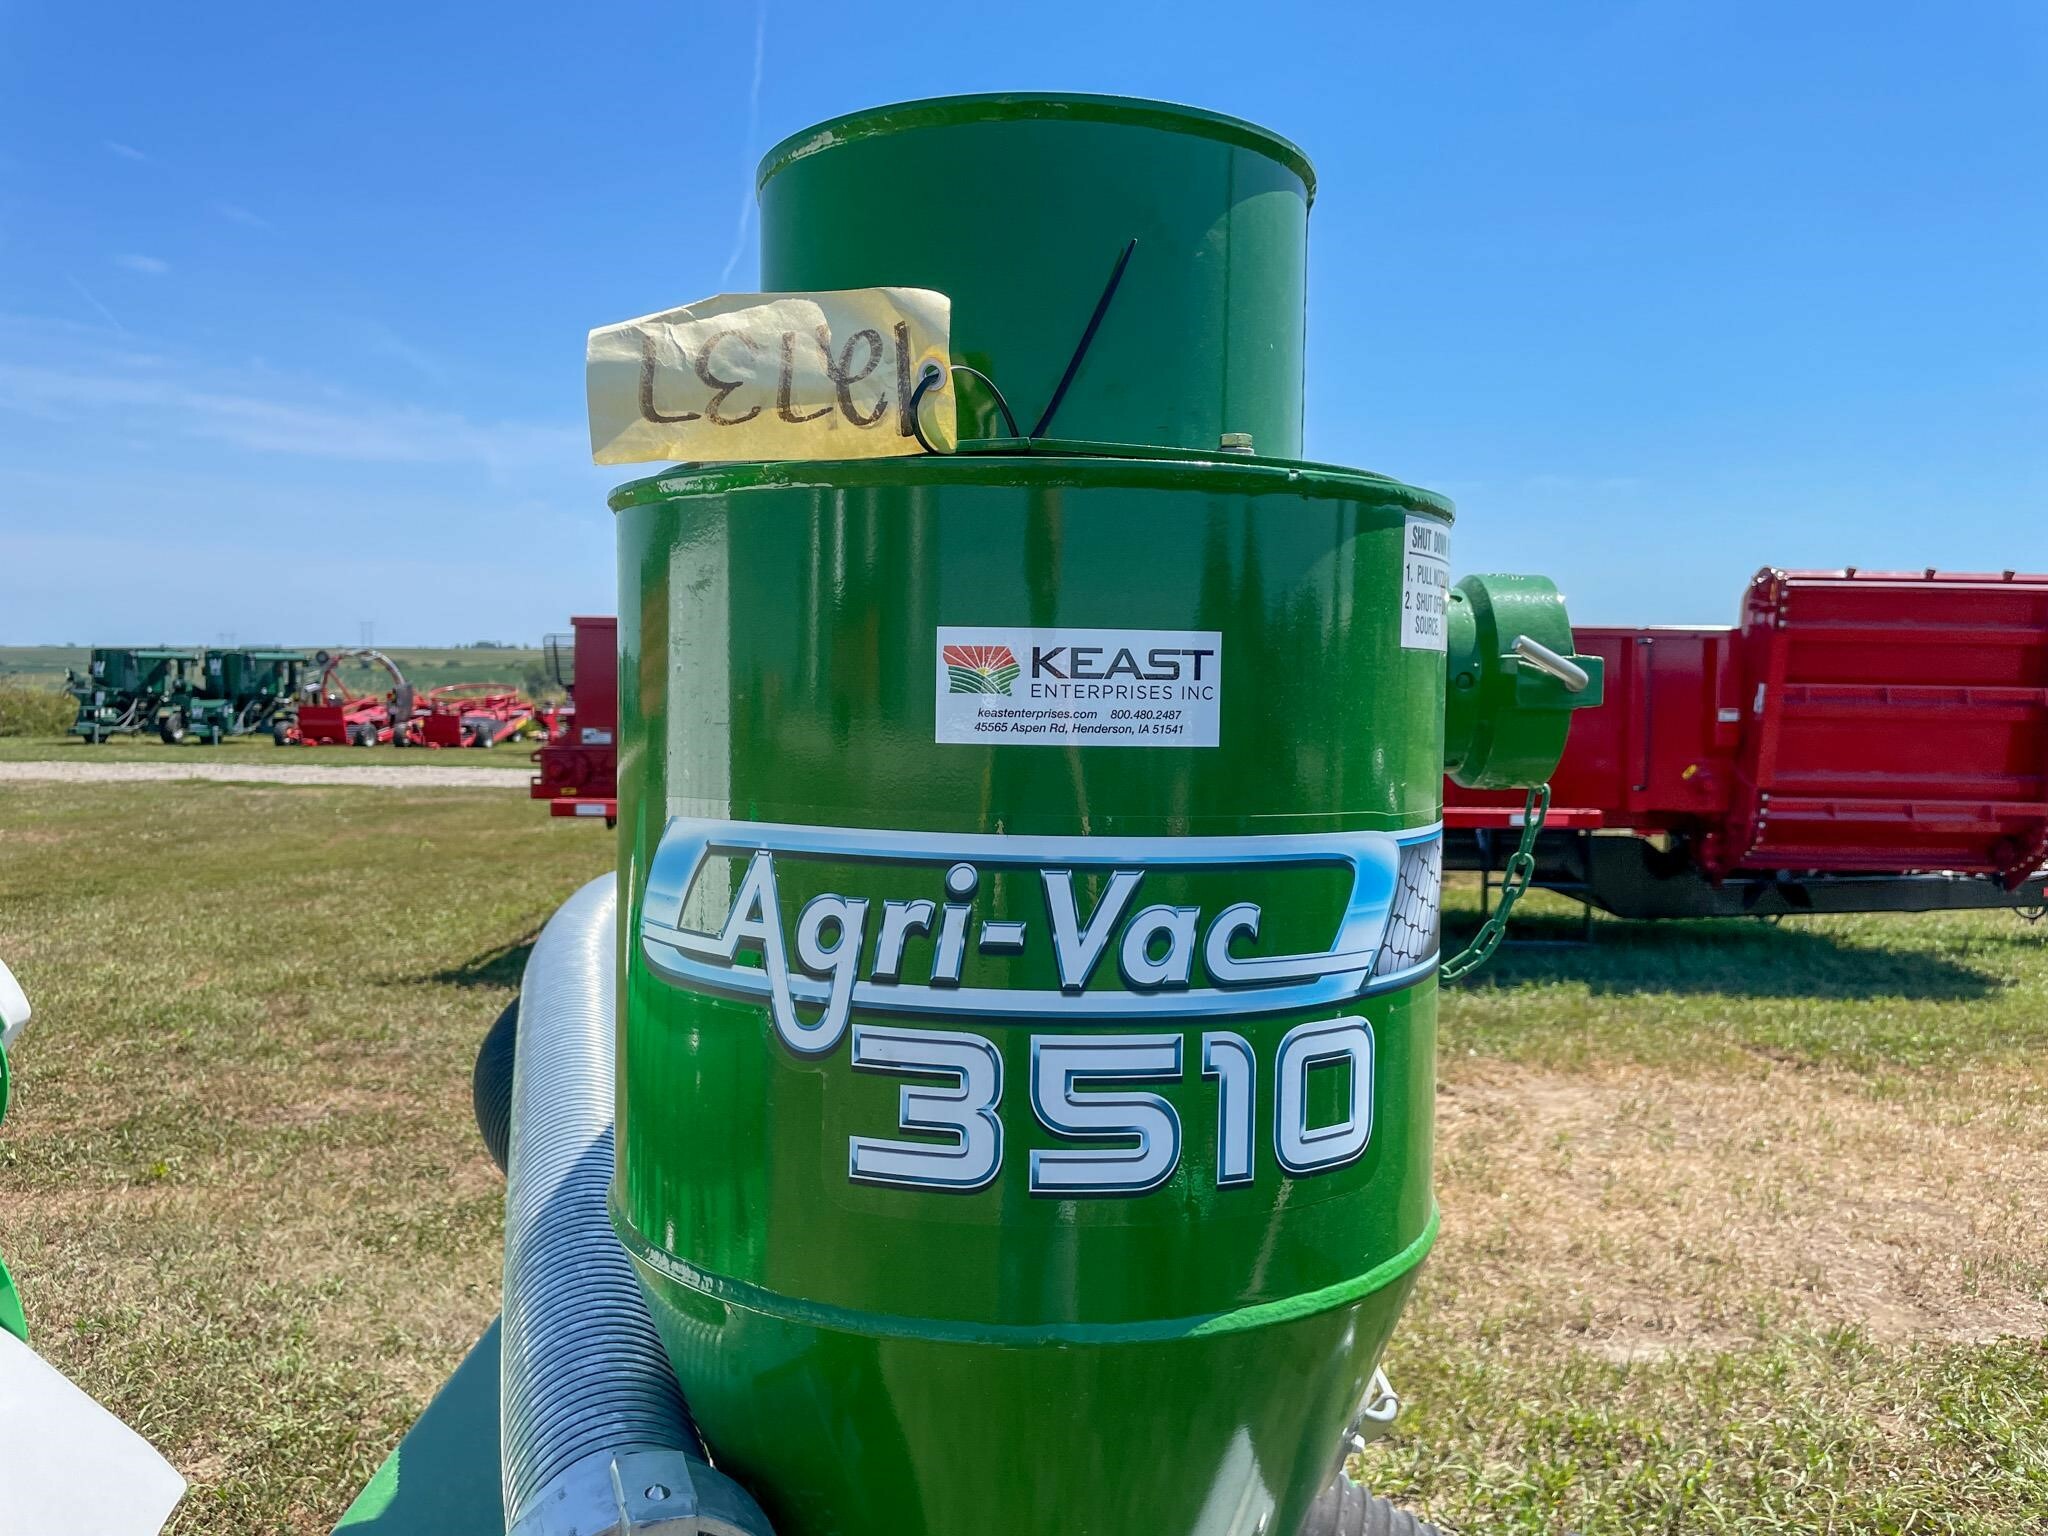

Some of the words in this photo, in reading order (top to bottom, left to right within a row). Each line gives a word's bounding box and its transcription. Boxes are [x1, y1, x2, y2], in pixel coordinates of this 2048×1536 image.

[1412, 524, 1432, 551] SHUT
[1406, 563, 1413, 582] 1.
[1416, 564, 1433, 585] PULL
[1404, 591, 1413, 610] 2.
[1416, 592, 1433, 612] SHUT
[1031, 646, 1214, 681] KEAST
[1030, 683, 1173, 700] ENTERPRISES
[1181, 685, 1214, 701] INC
[977, 707, 1098, 720] keastenterprises.com
[1110, 708, 1182, 720] 800.480.2487
[974, 722, 1008, 733] 45565
[1010, 723, 1046, 735] Aspen
[1049, 723, 1069, 735] Rd,
[1072, 723, 1136, 736] Henderson,
[1138, 724, 1150, 735] IA
[1152, 724, 1184, 735] 51541
[720, 848, 1265, 1055] Agri-Vac
[848, 1015, 1377, 1196] 3510
